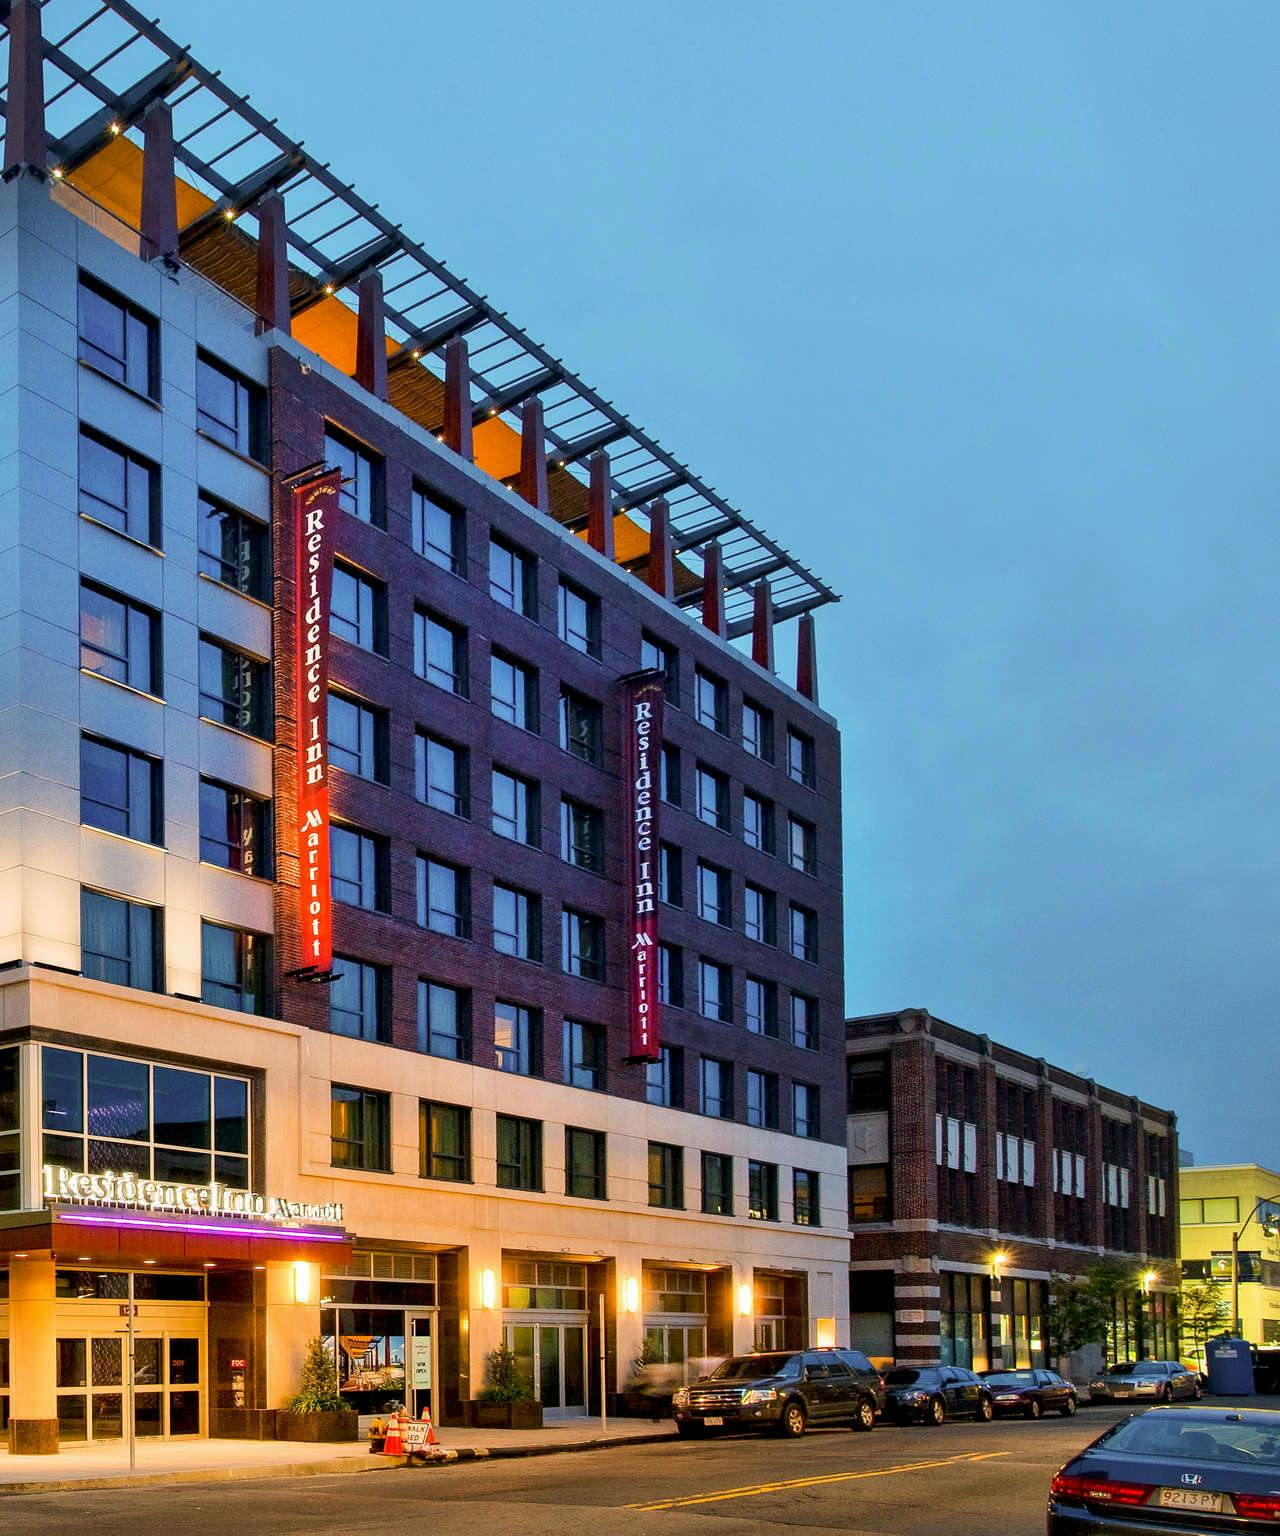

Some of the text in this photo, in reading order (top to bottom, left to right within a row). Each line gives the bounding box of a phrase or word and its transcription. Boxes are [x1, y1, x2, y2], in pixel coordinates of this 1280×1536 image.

[301, 509, 325, 957] Residence Inn Marriott
[631, 702, 654, 1046] Residence Inn Marriott
[44, 1164, 344, 1222] Residence Inn Marriott
[1163, 1491, 1219, 1506] 9213 PY
